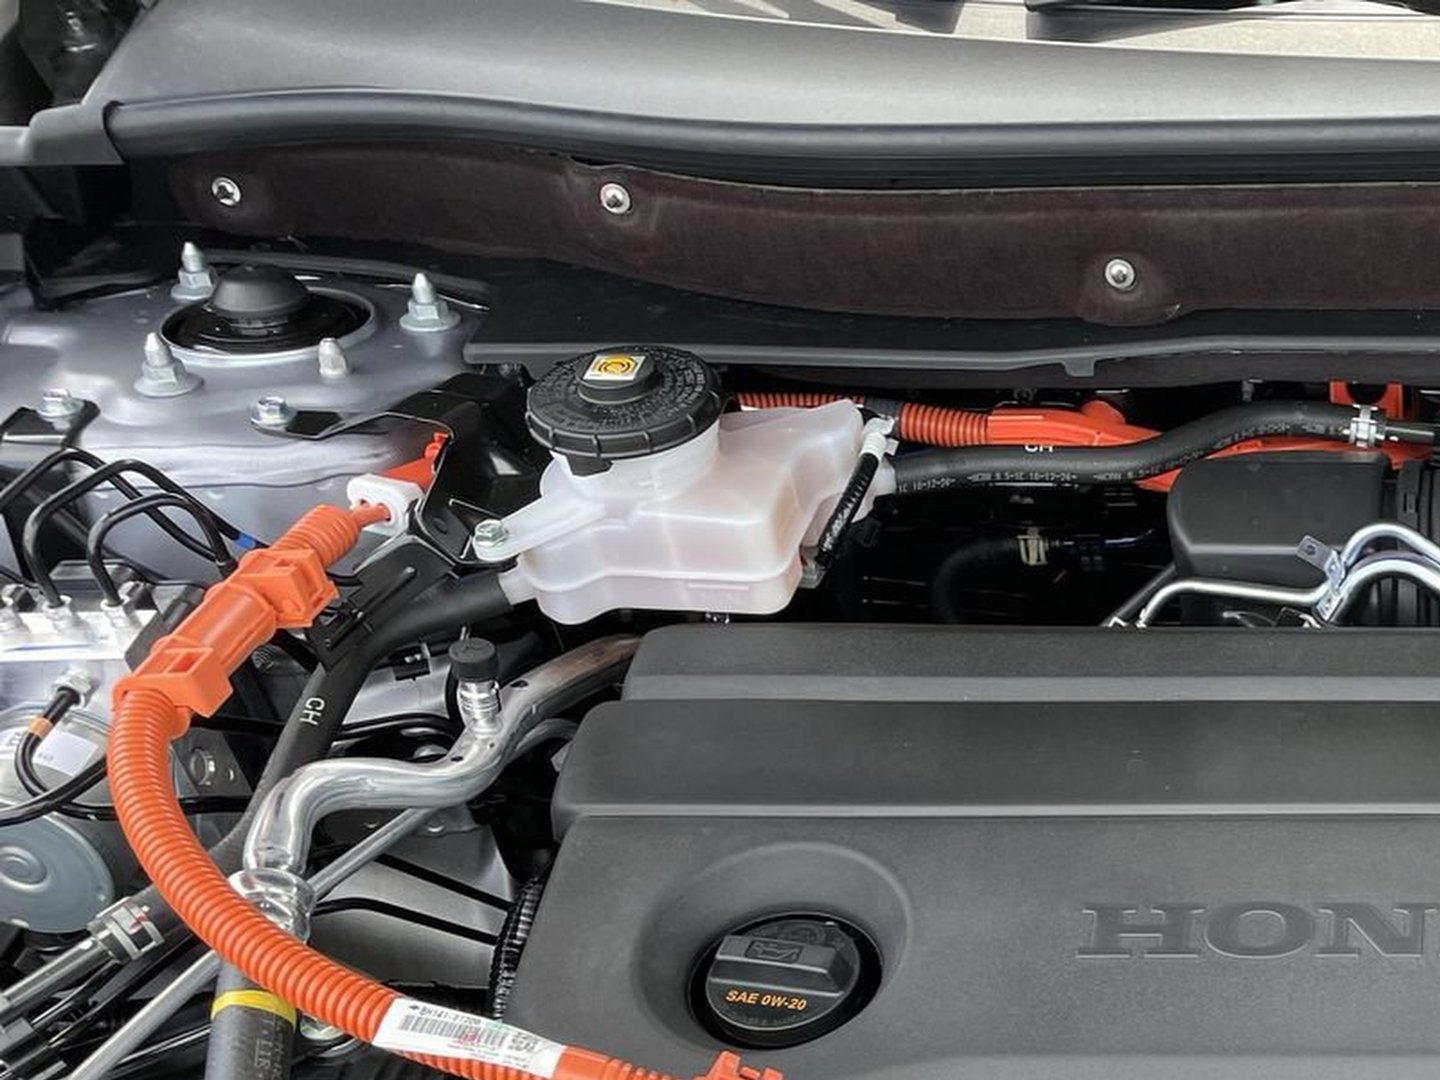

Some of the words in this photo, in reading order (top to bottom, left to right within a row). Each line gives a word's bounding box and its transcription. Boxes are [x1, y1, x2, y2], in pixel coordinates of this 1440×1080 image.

[299, 697, 325, 725] CH
[726, 990, 759, 1005] SAE
[761, 994, 808, 1011] 0W-20
